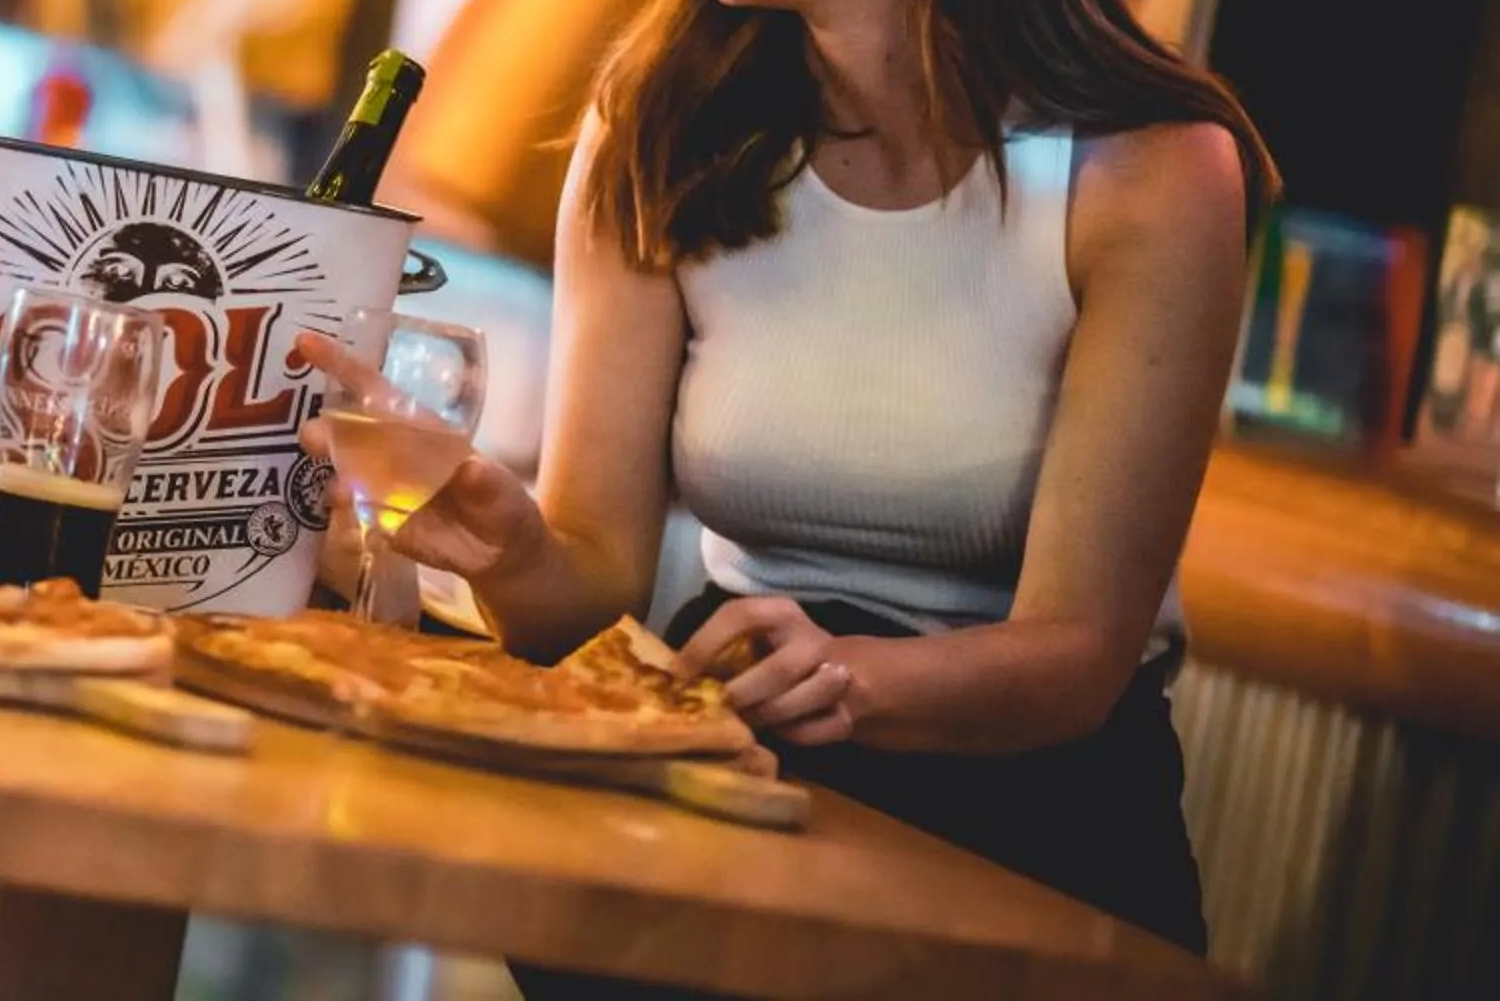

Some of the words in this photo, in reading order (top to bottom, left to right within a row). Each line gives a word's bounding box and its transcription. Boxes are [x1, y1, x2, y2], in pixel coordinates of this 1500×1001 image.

[121, 467, 280, 505] CERVEZA
[116, 526, 246, 552] ORIGINAL
[102, 553, 212, 581] MÉXICO
